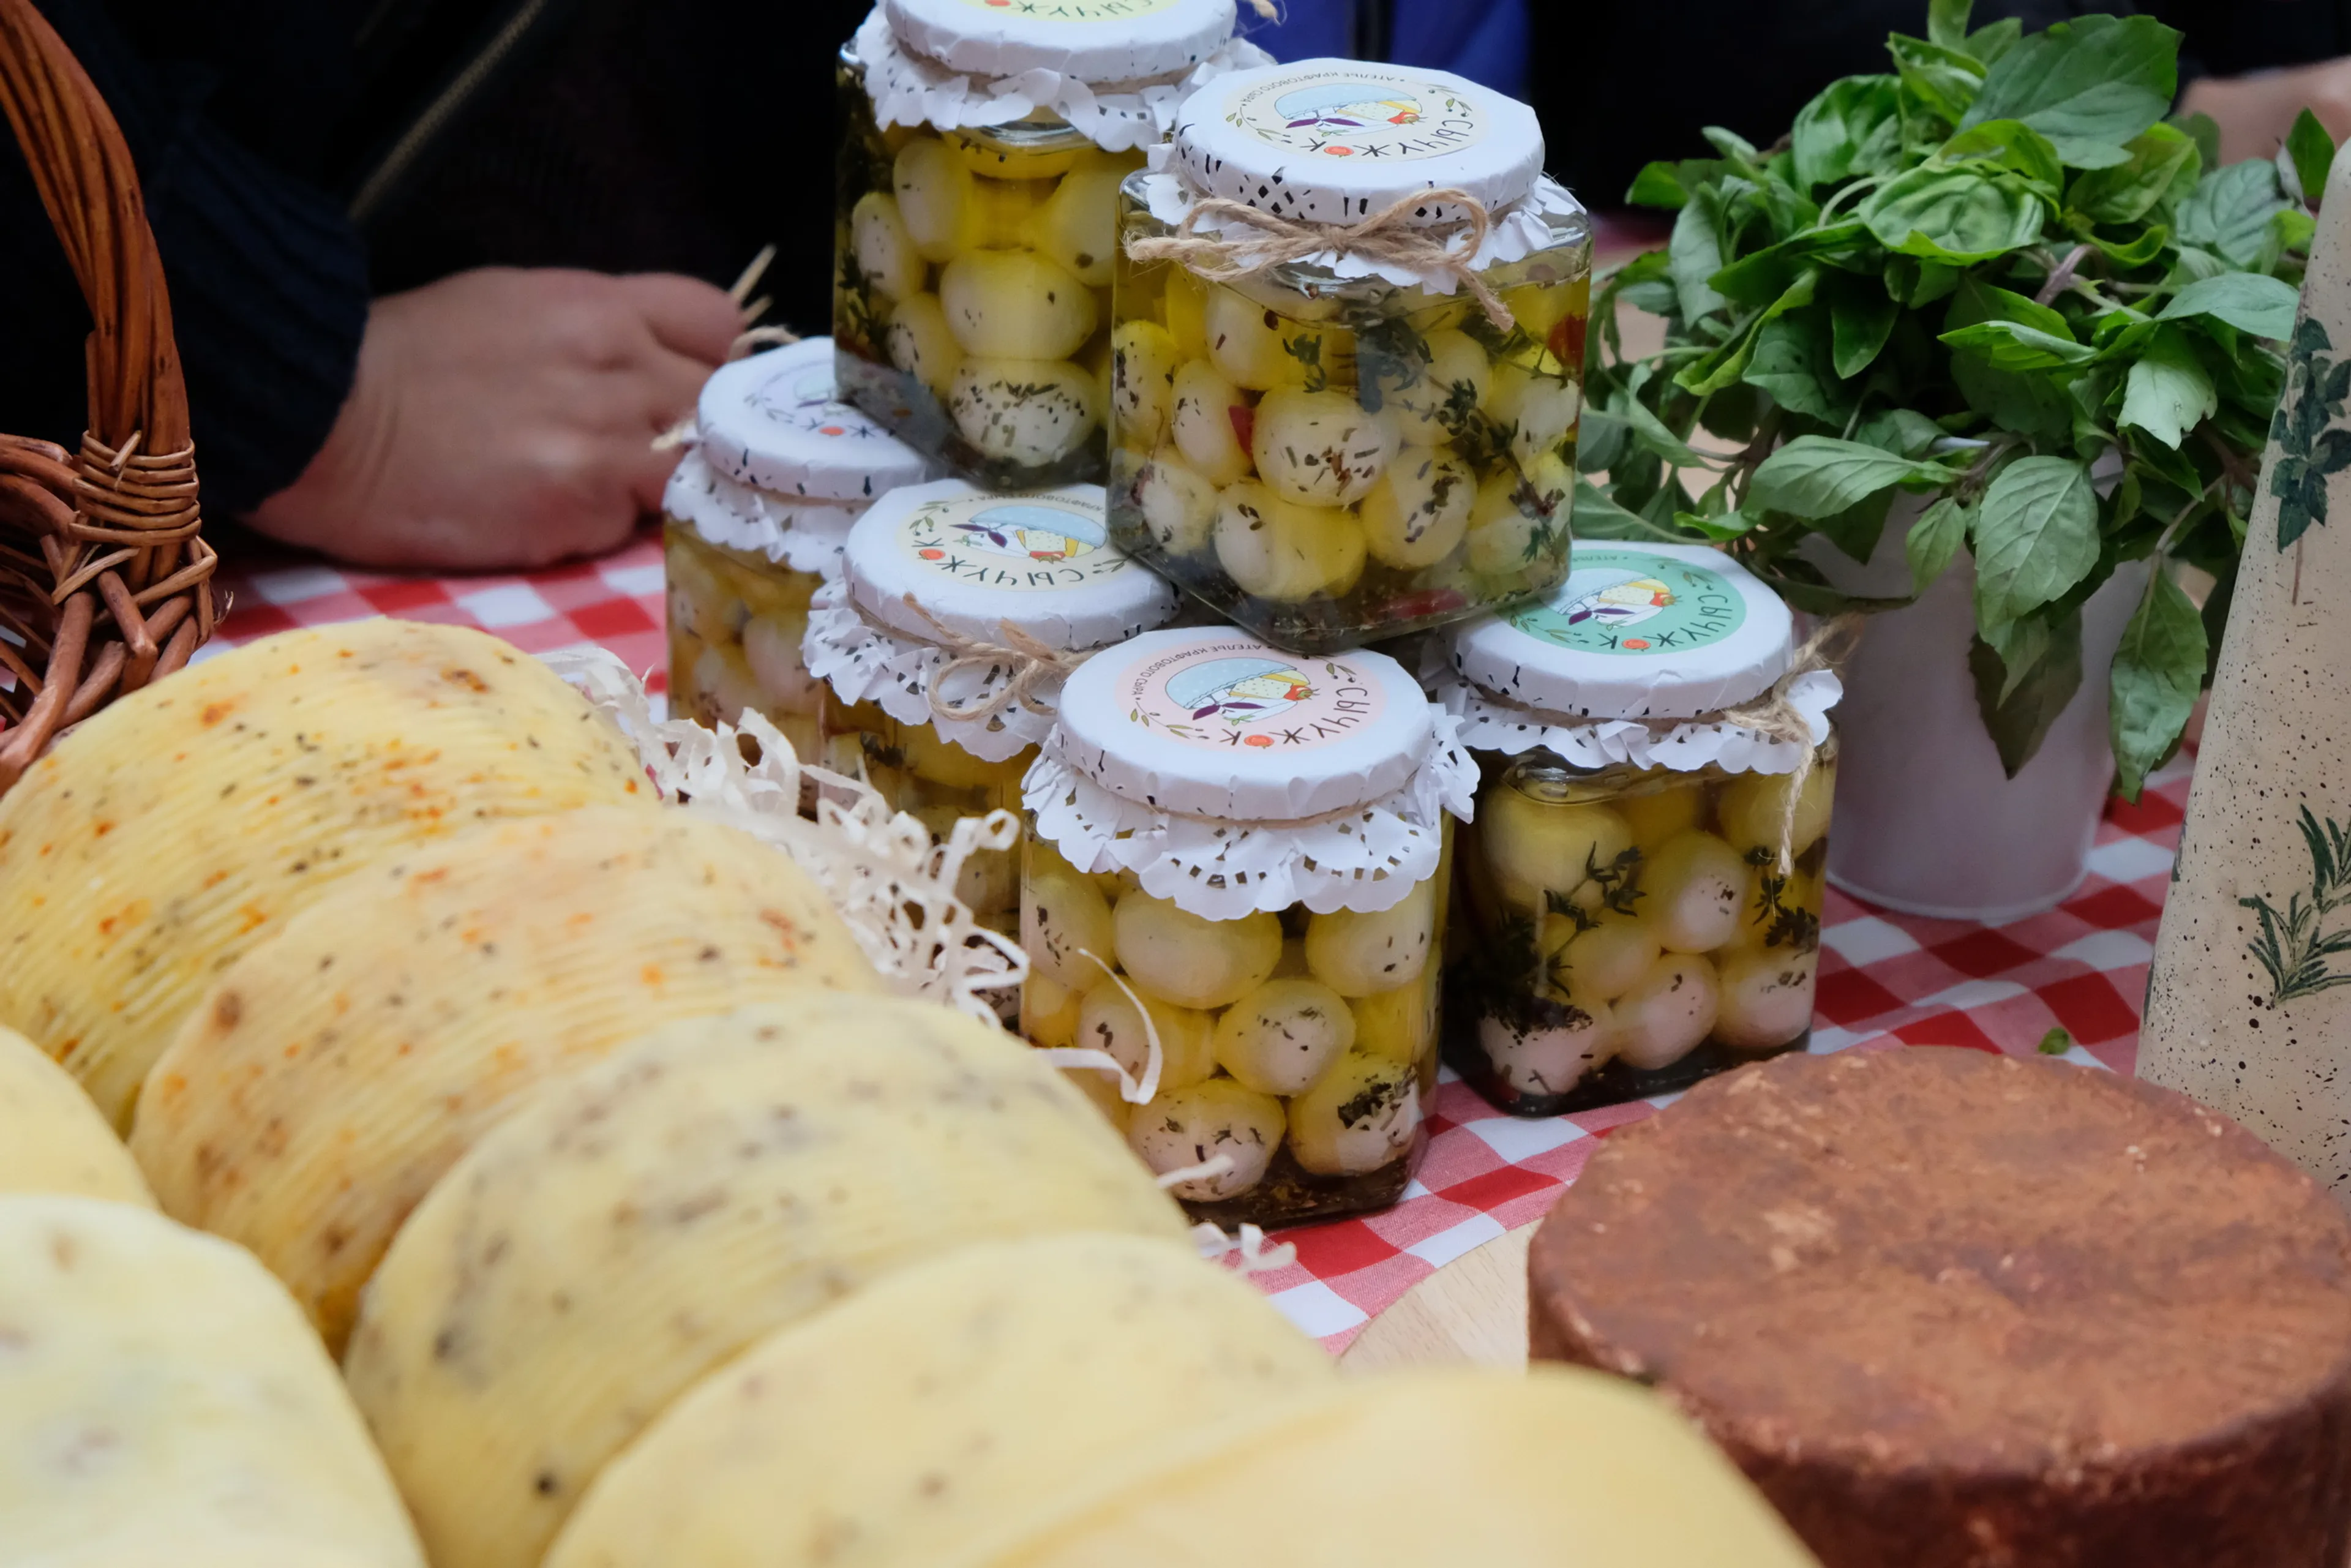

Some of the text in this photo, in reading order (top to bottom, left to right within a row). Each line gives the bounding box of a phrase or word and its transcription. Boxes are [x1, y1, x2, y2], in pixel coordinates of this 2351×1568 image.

[1344, 71, 1395, 82] АТЕЛЬЕ
[1131, 643, 1262, 696] АТЕЛЬЕ КРАФТОВОГО СЫРА
